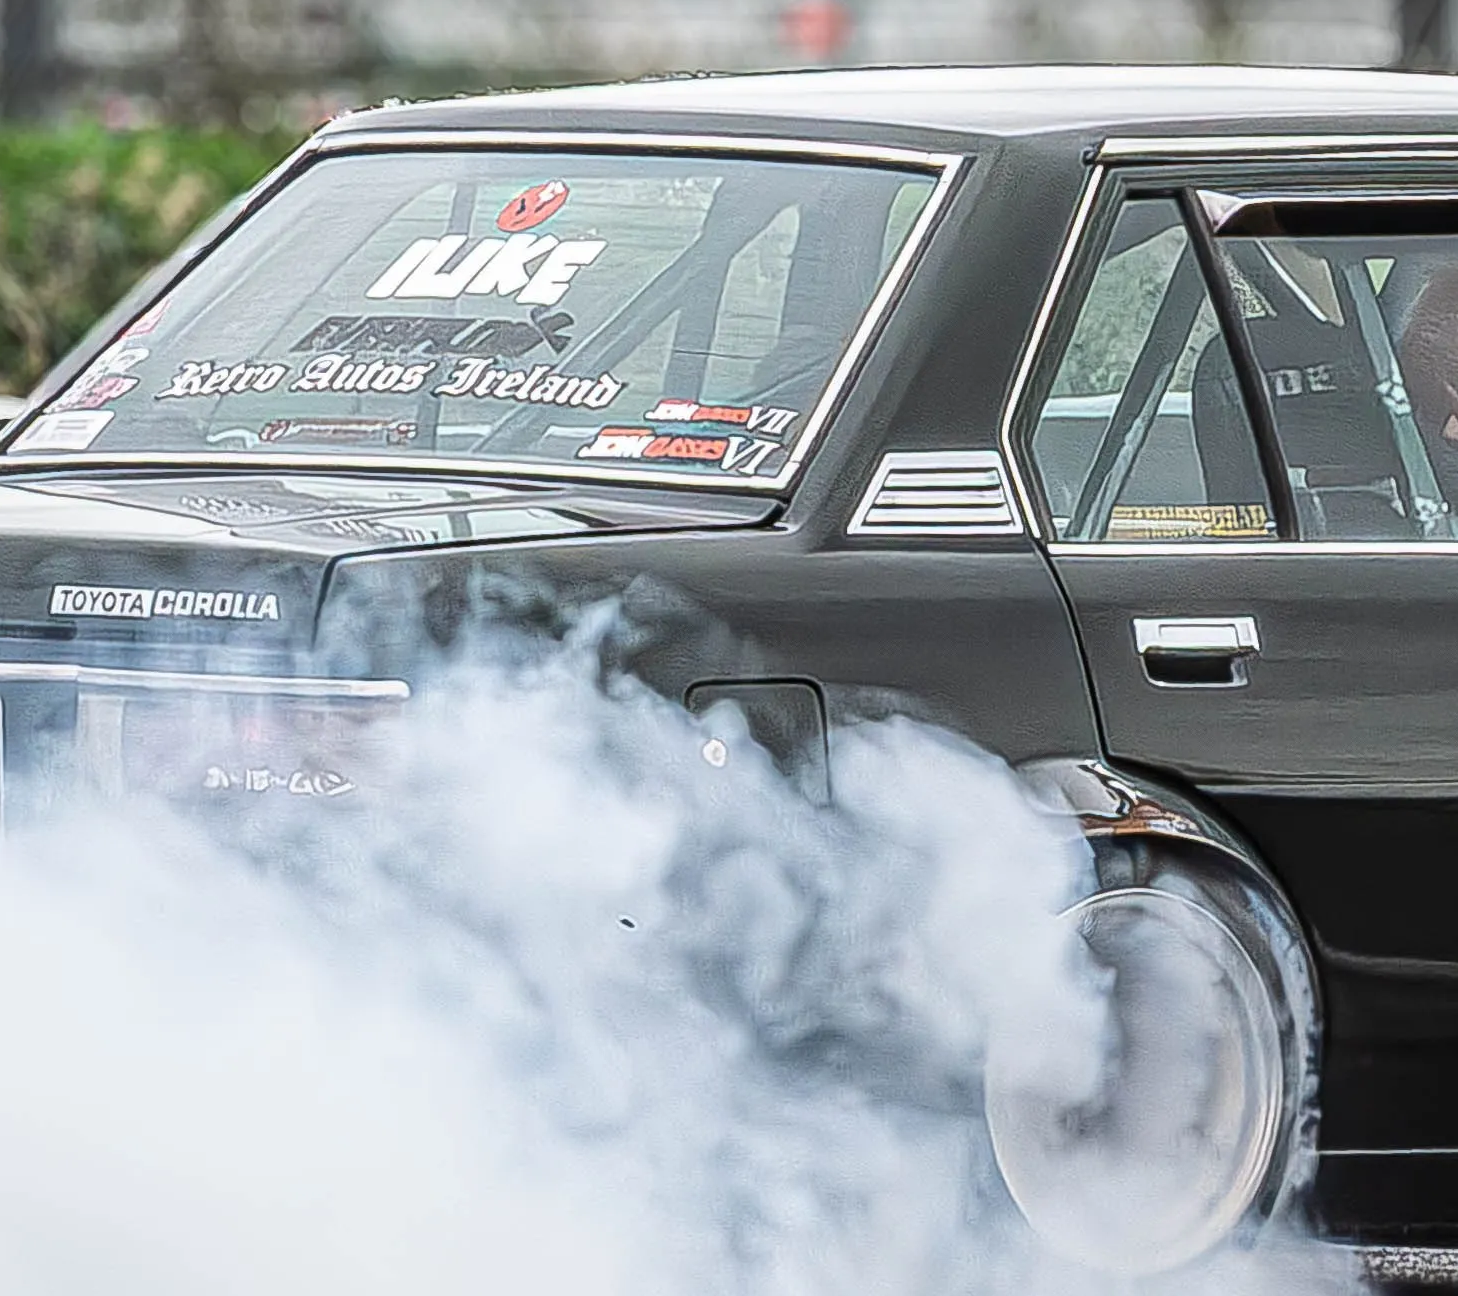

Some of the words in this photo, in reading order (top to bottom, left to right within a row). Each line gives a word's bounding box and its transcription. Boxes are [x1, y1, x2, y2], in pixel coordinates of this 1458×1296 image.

[155, 360, 290, 399] Retro
[290, 353, 437, 394] Autos
[432, 356, 626, 410] Ireland
[60, 589, 144, 614] TOYOTA
[153, 590, 279, 620] COROLLA
